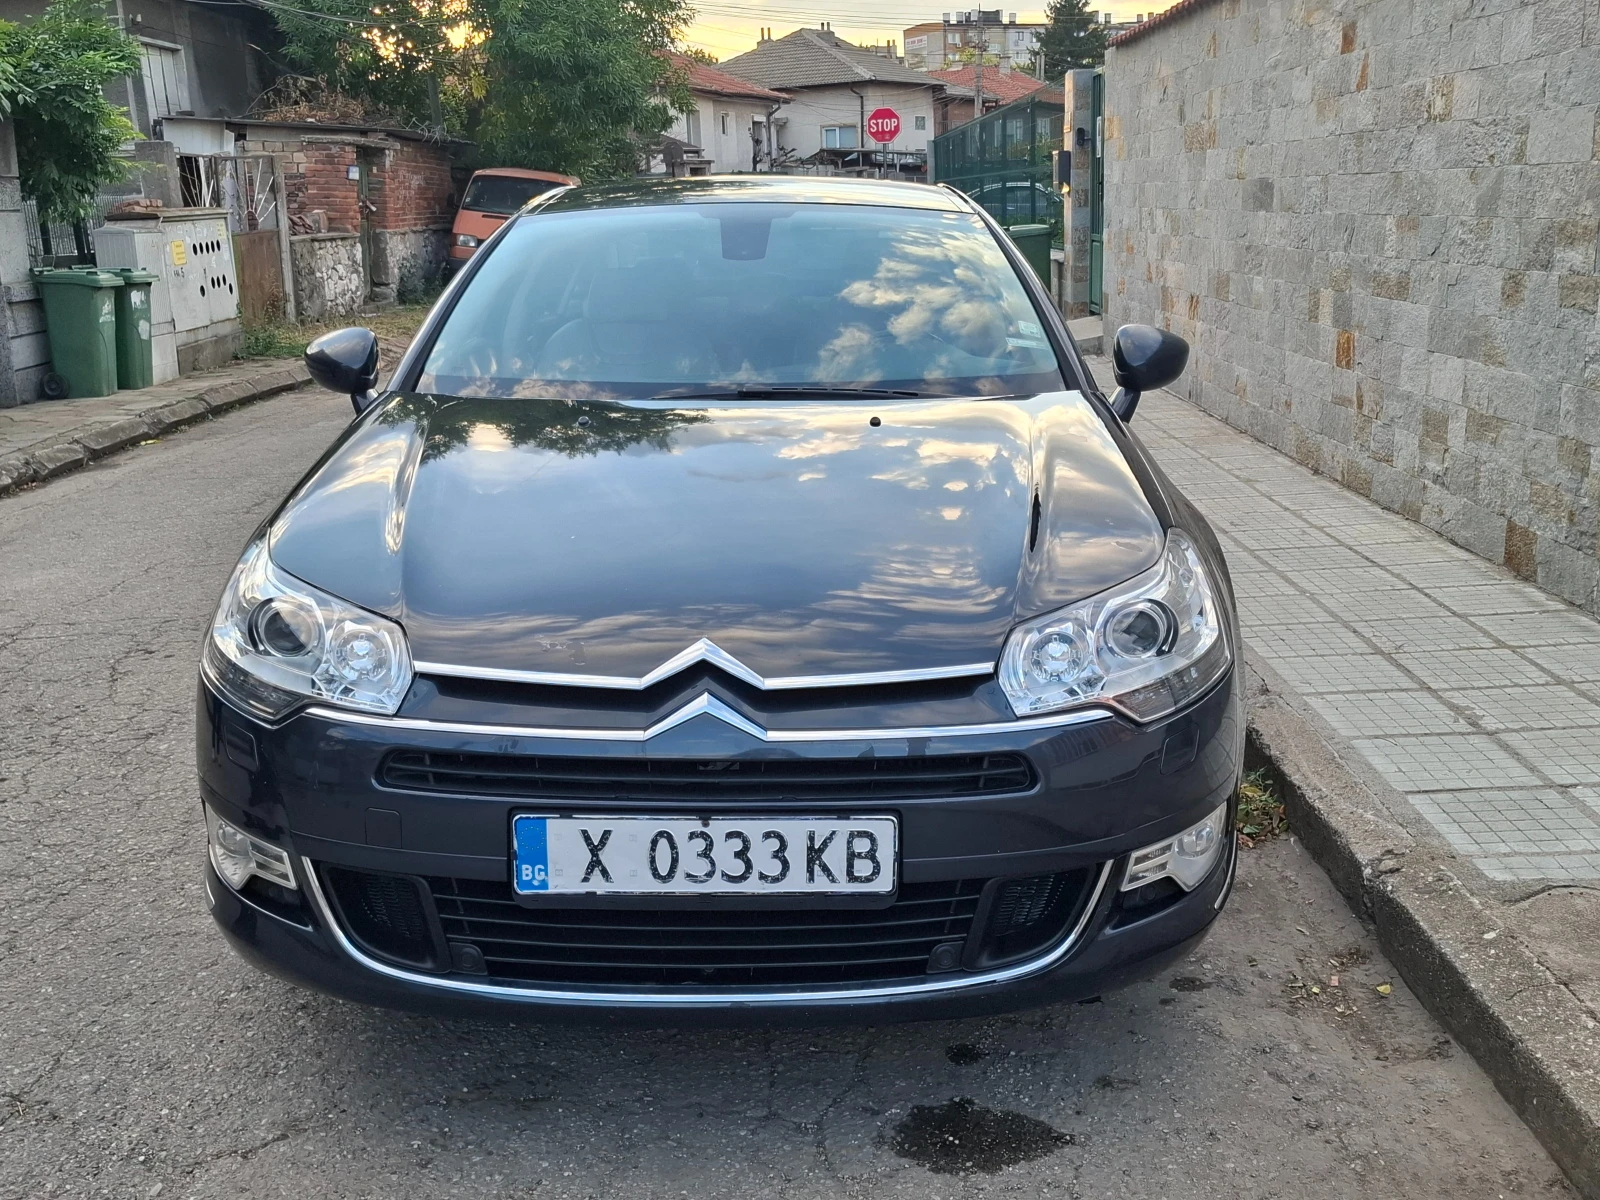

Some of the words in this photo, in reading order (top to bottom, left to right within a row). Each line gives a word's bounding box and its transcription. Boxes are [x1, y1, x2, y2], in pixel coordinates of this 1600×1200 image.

[870, 118, 898, 132] STOP
[578, 829, 615, 884] X
[648, 829, 791, 884] 0333
[806, 829, 882, 884] KB
[522, 864, 546, 881] BG
